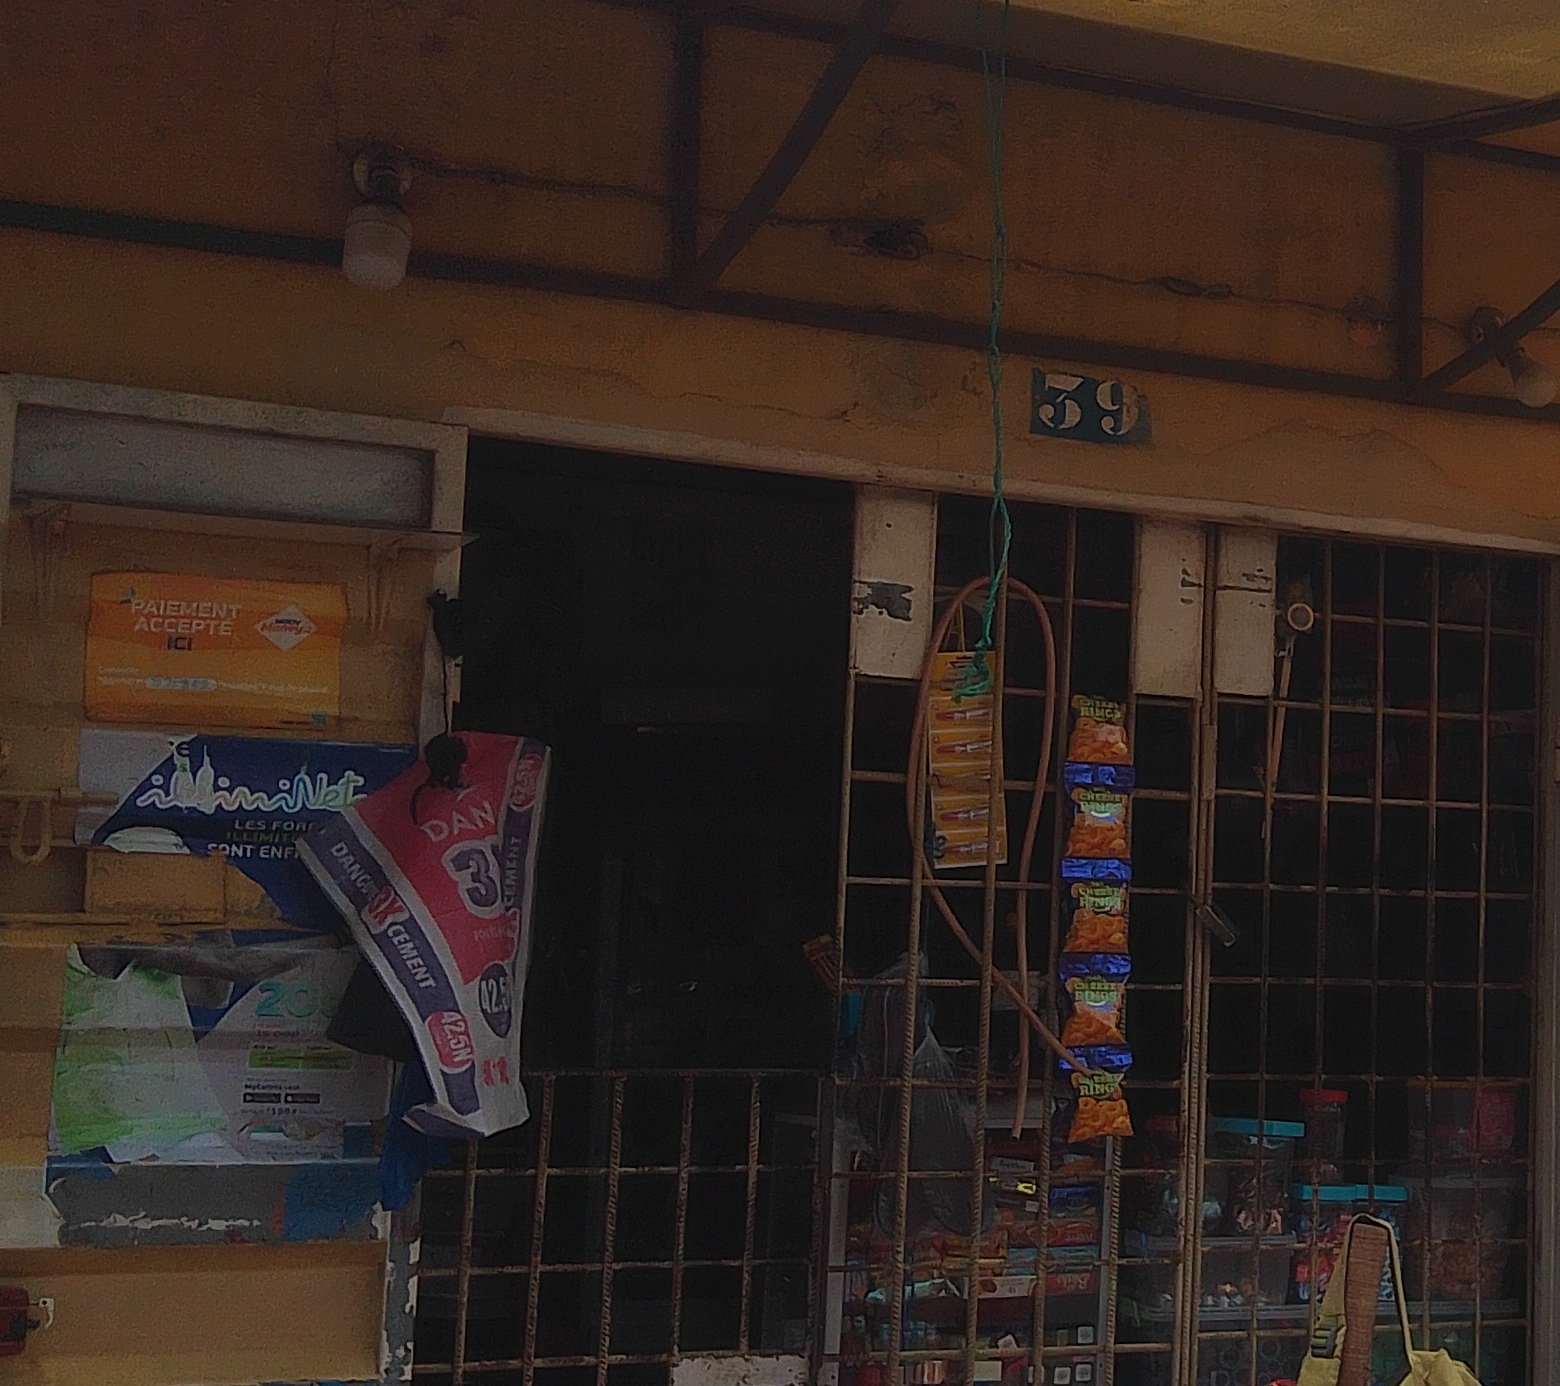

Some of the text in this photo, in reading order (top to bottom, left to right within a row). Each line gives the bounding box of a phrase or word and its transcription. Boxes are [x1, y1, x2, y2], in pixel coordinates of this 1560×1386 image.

[130, 598, 242, 619] PAIEMENT
[167, 636, 192, 651] ICI
[233, 820, 267, 831] LES
[226, 831, 296, 844] ILLIMIT
[386, 921, 437, 989] CEMENT
[1079, 1082, 1116, 1096] RING
